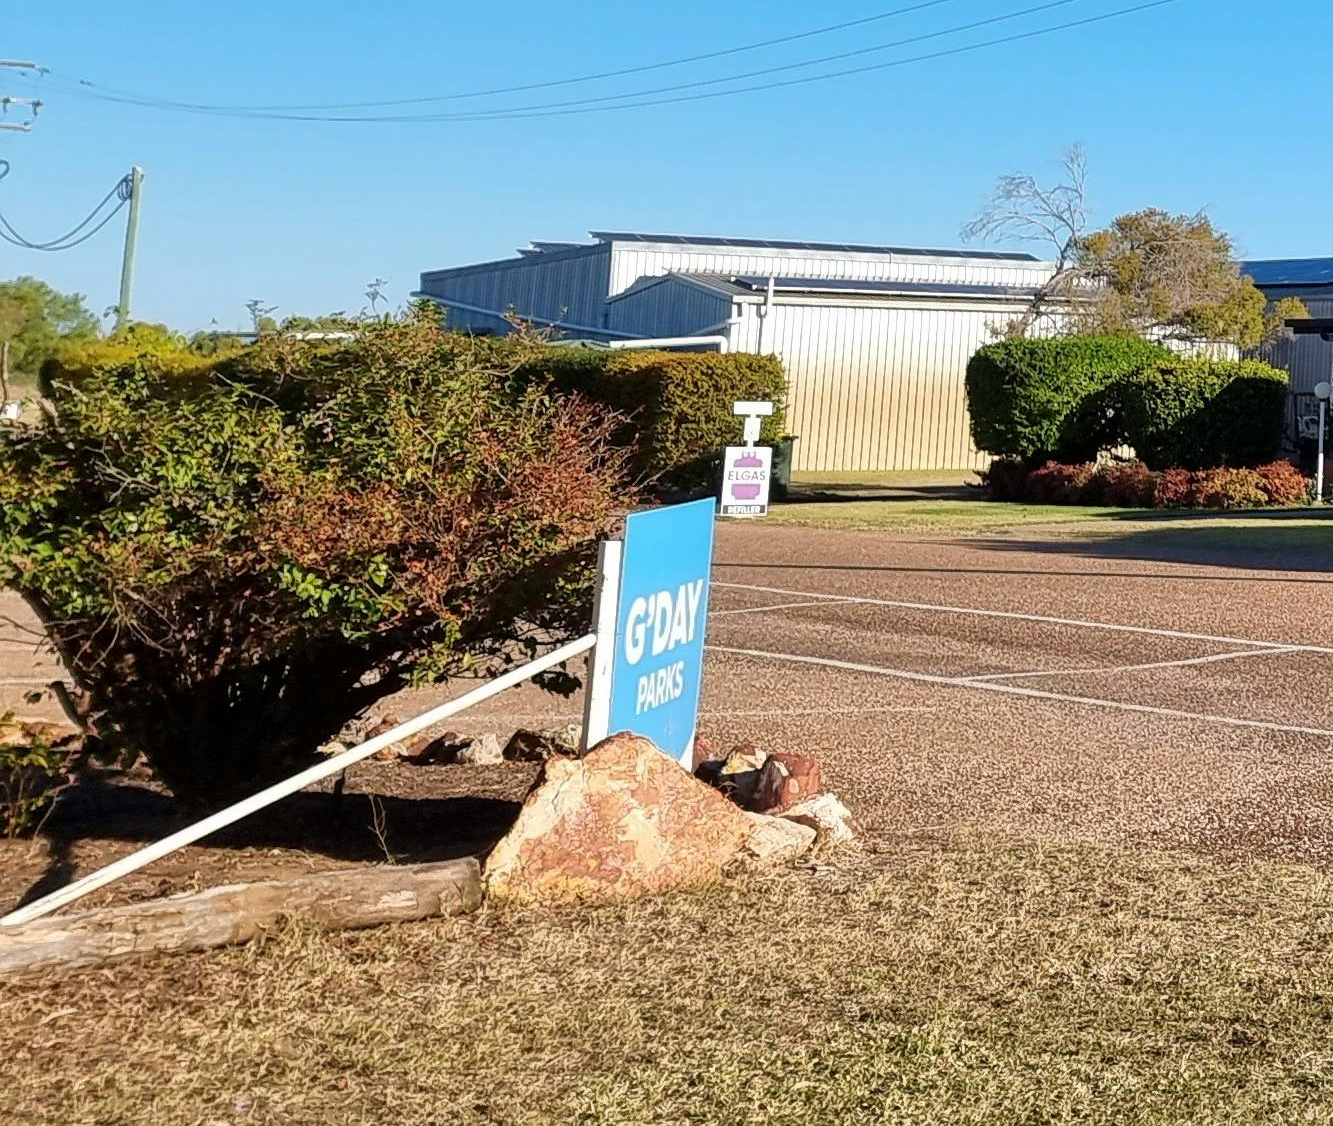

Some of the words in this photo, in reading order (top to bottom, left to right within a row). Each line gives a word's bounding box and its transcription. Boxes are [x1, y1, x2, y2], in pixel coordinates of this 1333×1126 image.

[727, 470, 766, 481] ELGAS
[624, 578, 704, 665] G'DAY
[635, 660, 684, 716] PARKS
